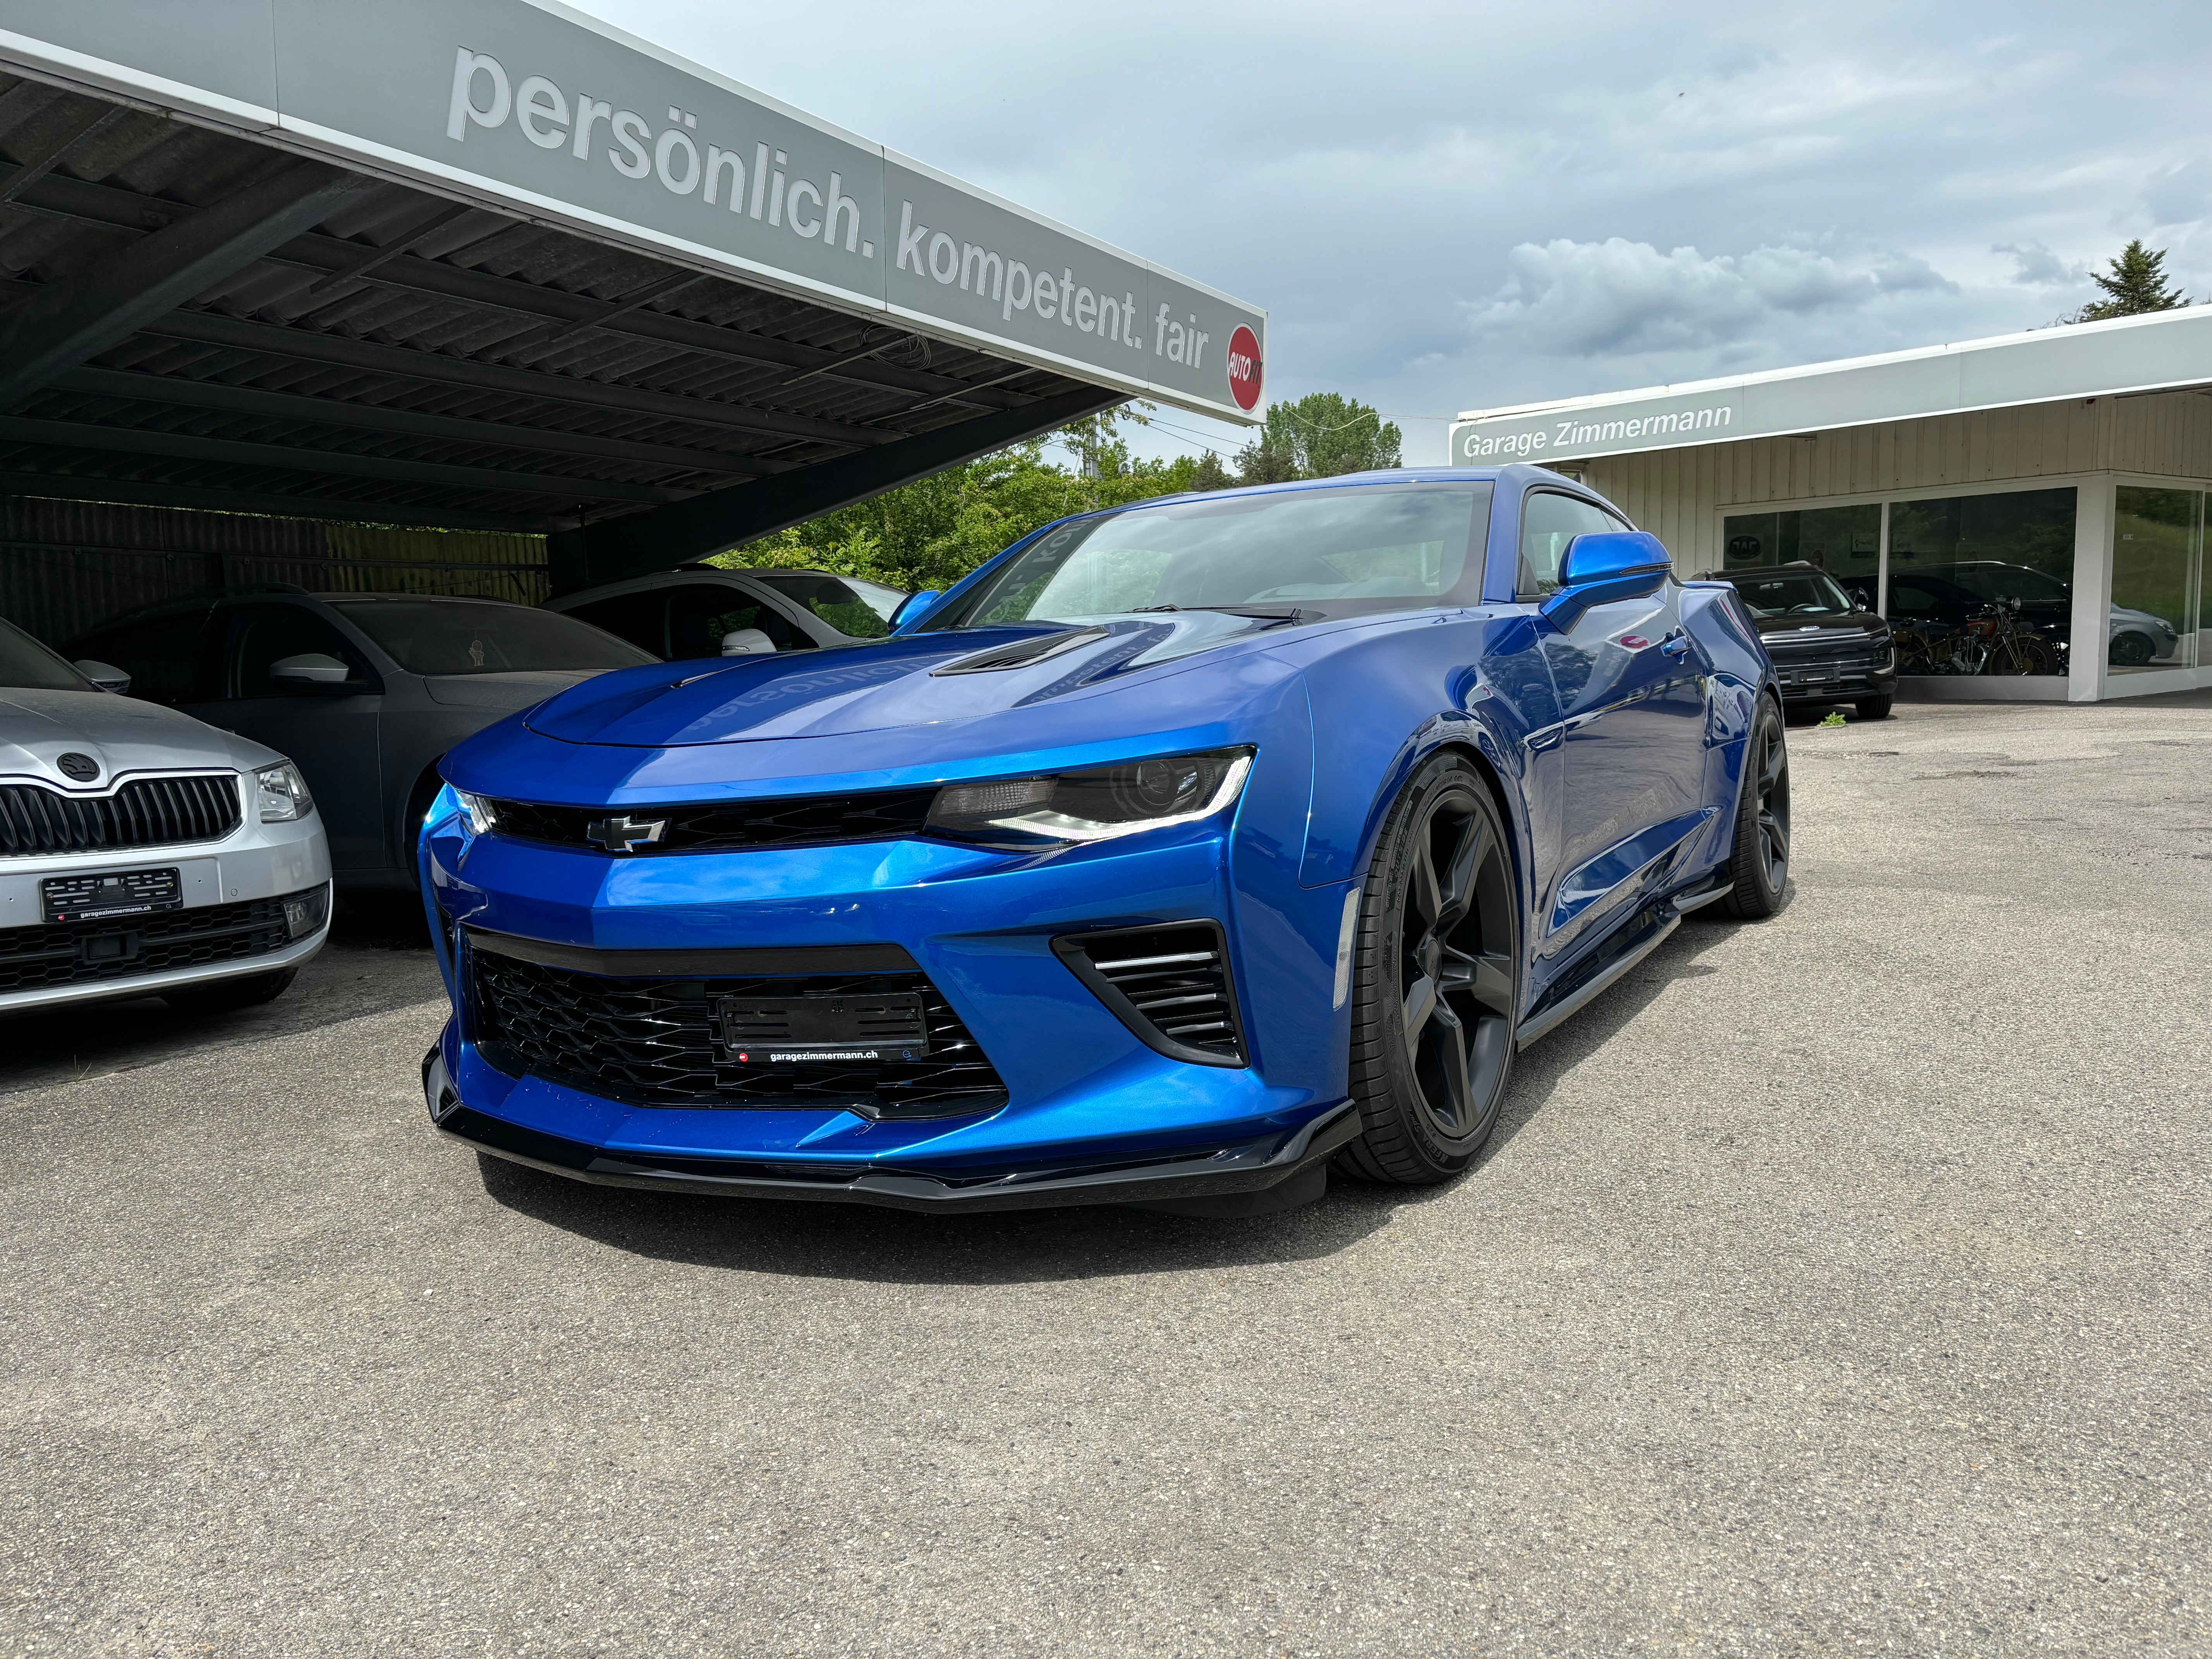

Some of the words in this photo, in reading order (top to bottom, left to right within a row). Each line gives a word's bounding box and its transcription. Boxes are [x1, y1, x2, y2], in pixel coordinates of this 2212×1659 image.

[446, 45, 874, 258] persönlich.
[896, 199, 1142, 349] kompetent.
[1155, 302, 1209, 368] fair
[1463, 431, 1546, 457] Garage
[1553, 406, 1731, 447] Zimmermann
[80, 905, 151, 919] garagezimmermann.ch
[770, 1050, 878, 1062] garagezimmermann.ch
